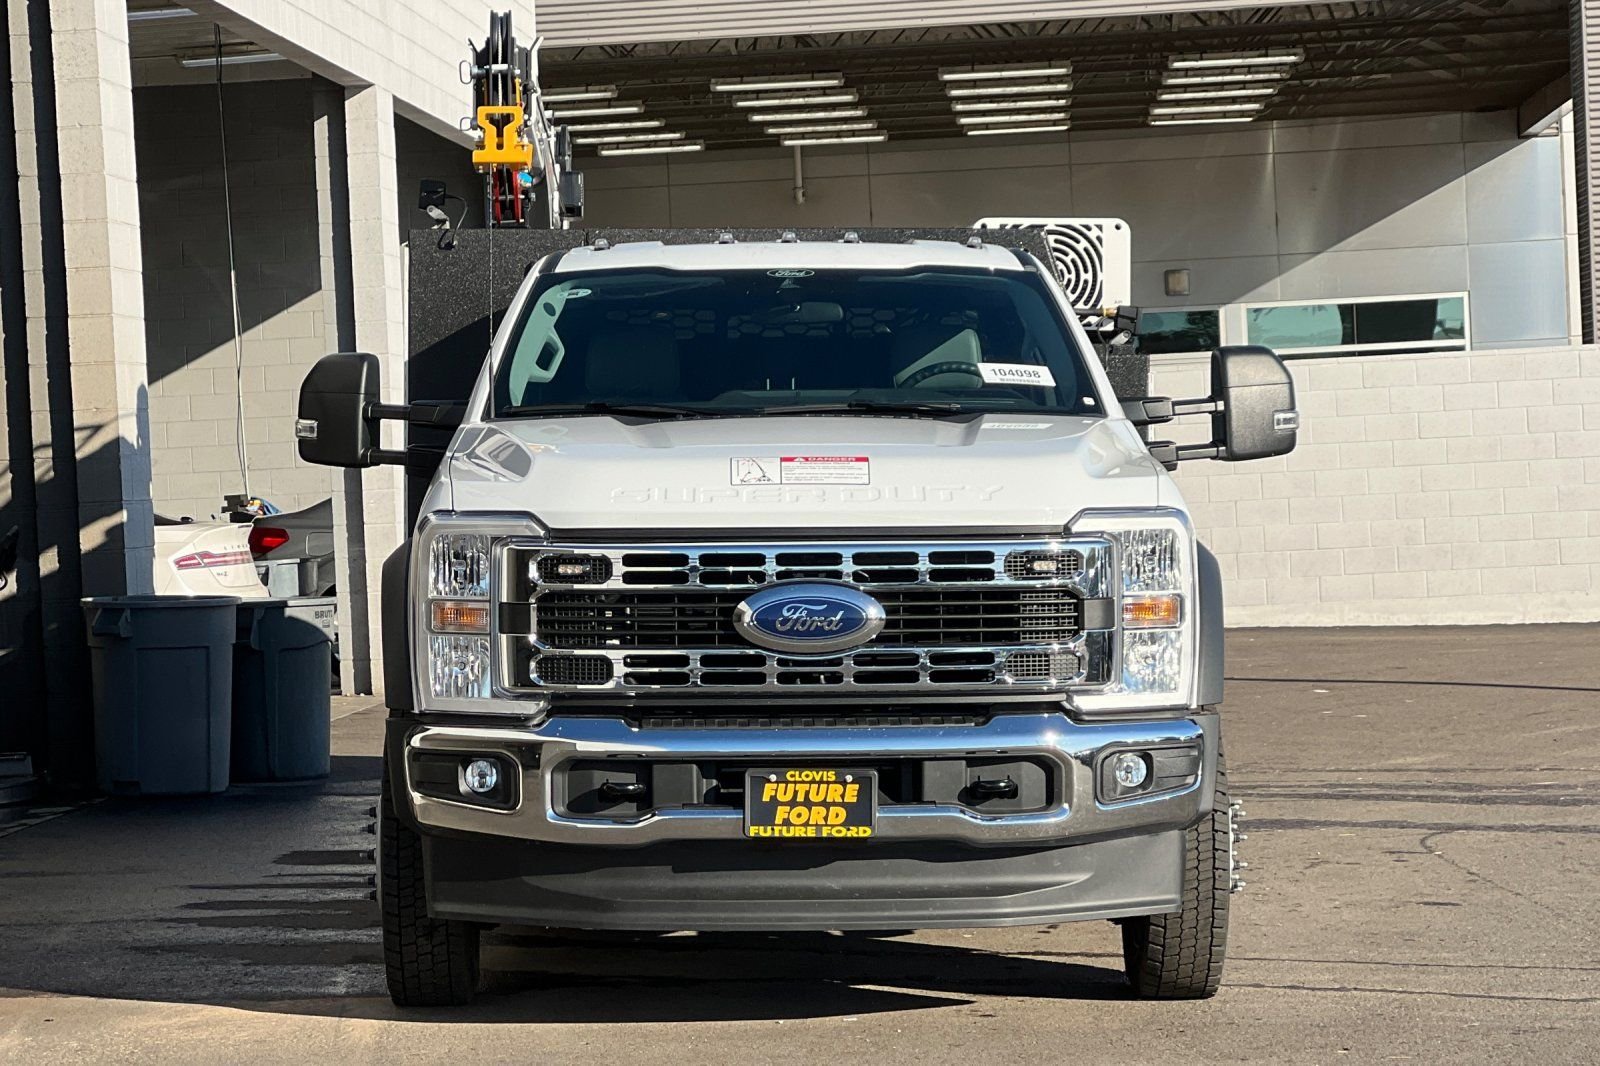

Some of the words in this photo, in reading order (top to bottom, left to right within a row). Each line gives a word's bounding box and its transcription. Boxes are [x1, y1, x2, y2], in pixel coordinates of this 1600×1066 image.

[990, 368, 1041, 378] 104098
[609, 486, 827, 503] SUPER
[840, 485, 1005, 503] DUTY
[775, 603, 844, 632] Ford
[786, 770, 836, 781] CLOVIS
[762, 783, 859, 803] FUTURE
[775, 805, 847, 825] FORD
[749, 826, 816, 837] FUTURE
[822, 826, 872, 837] FORD
